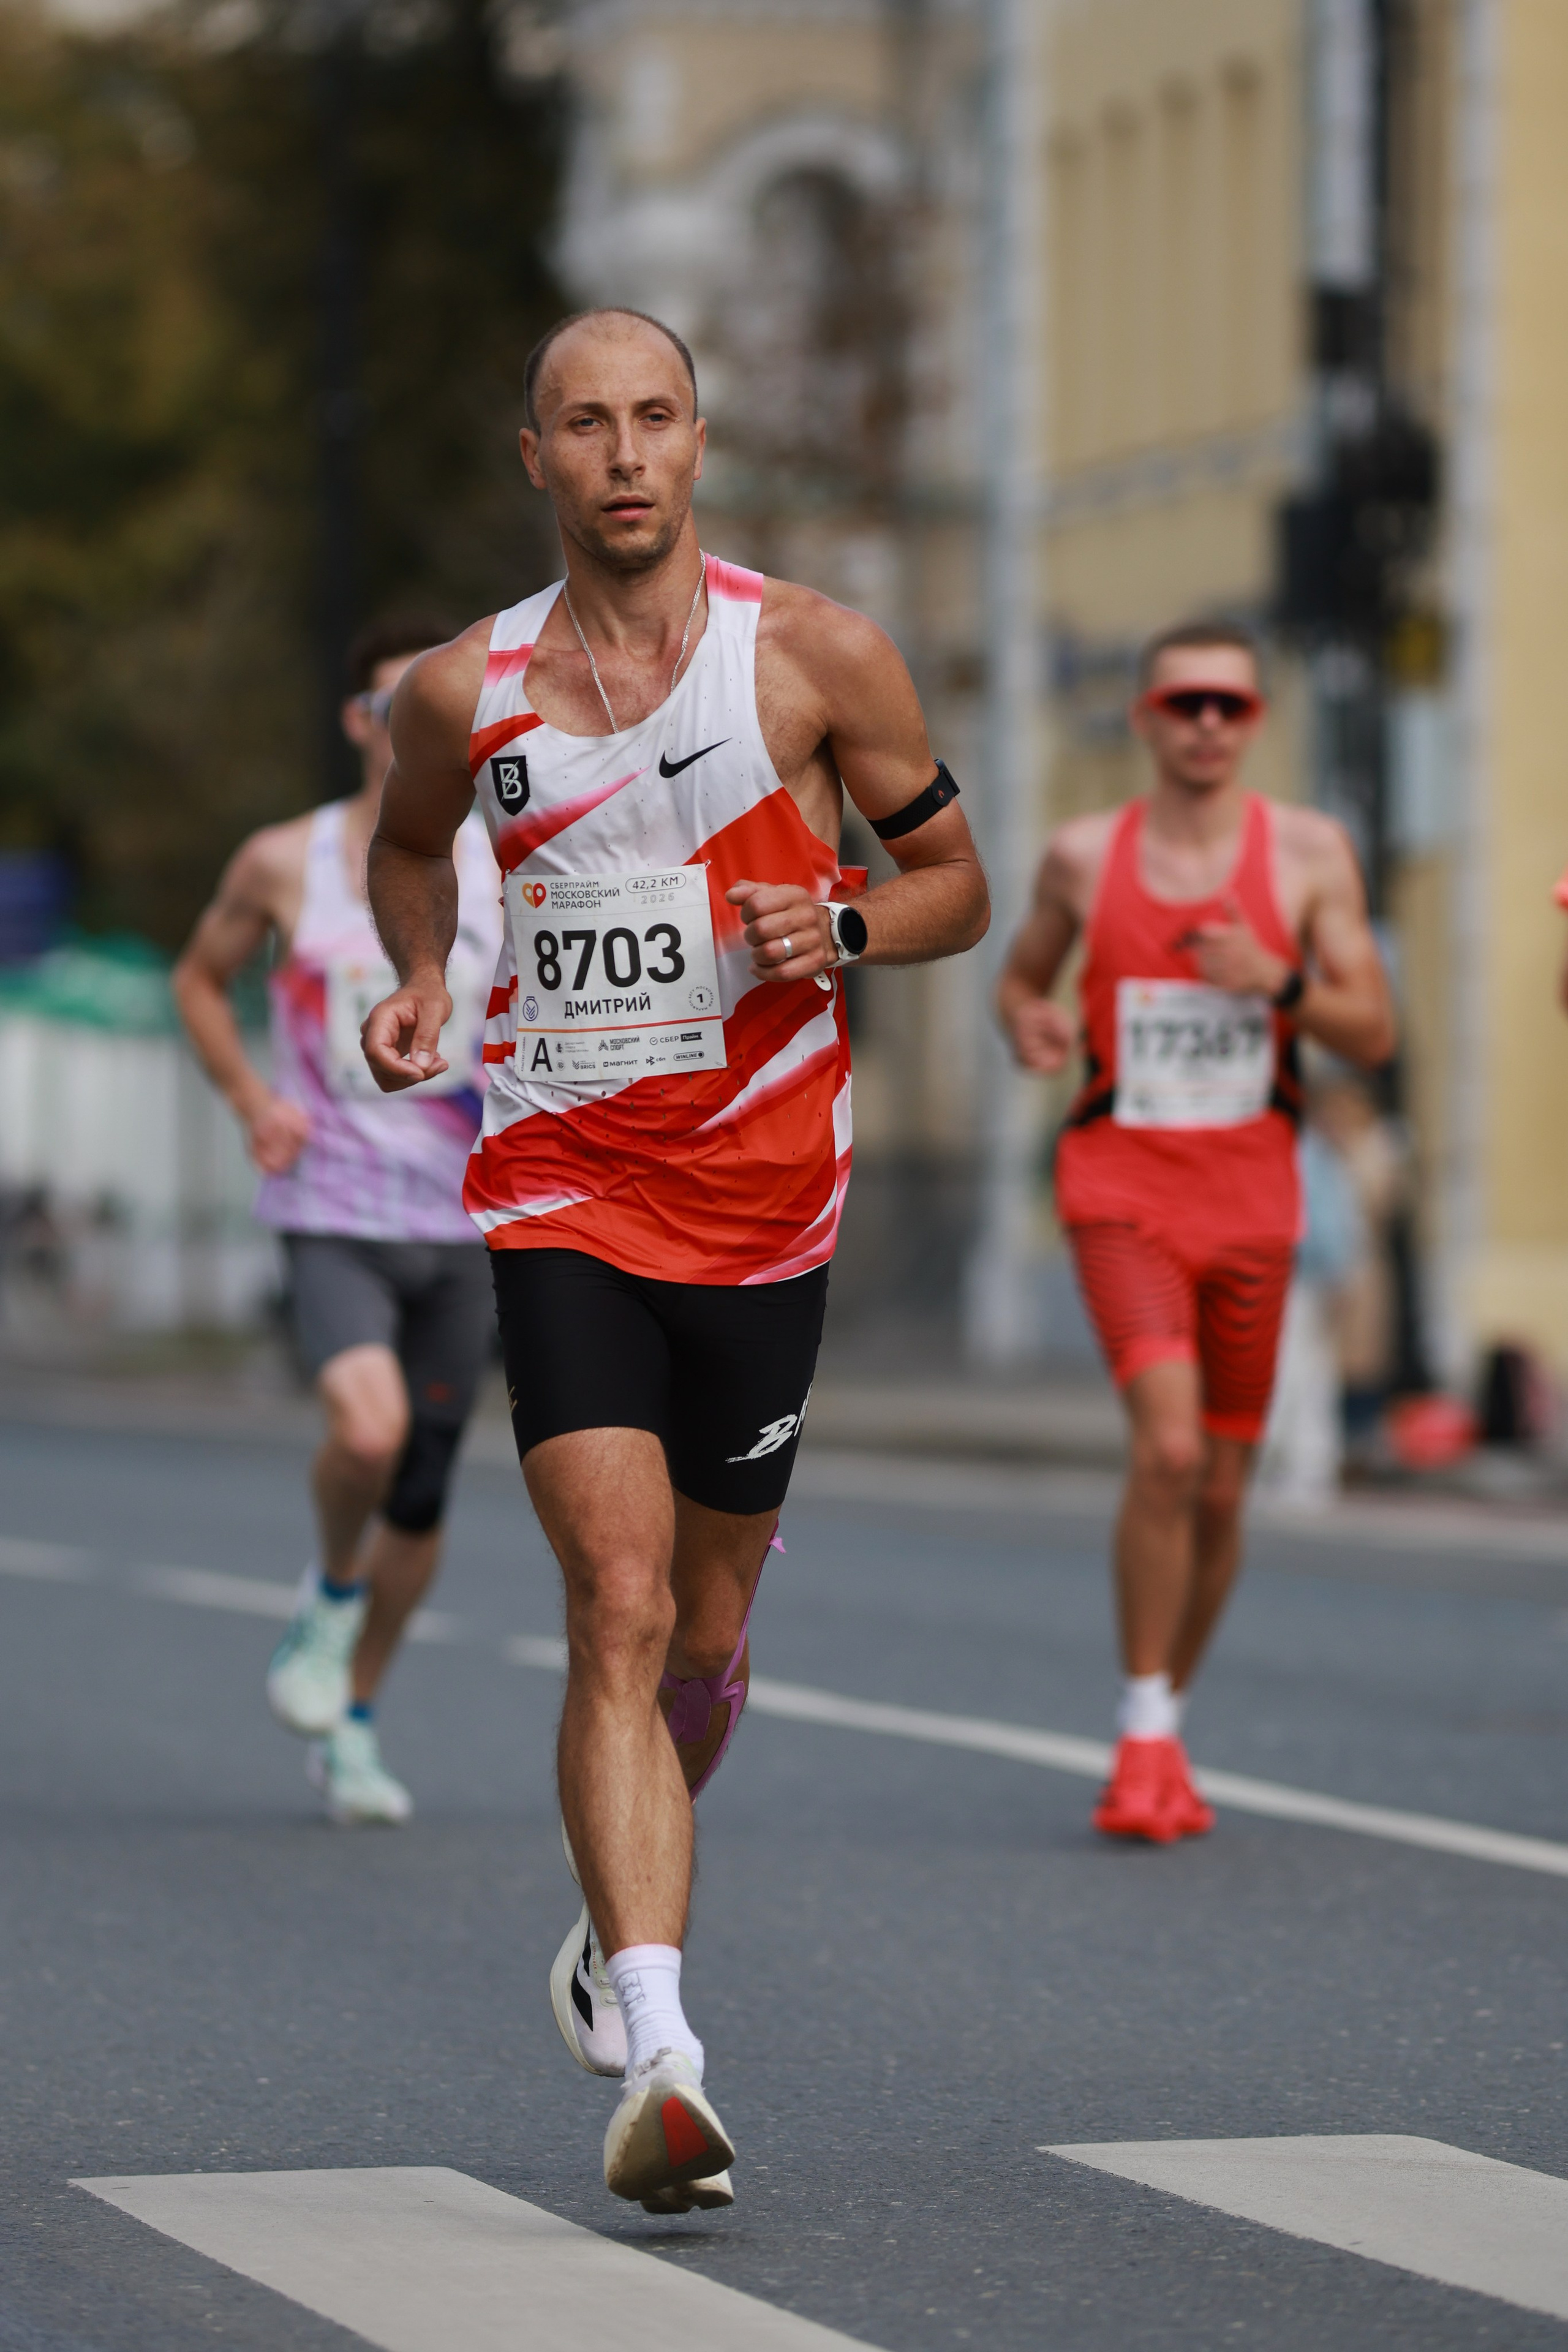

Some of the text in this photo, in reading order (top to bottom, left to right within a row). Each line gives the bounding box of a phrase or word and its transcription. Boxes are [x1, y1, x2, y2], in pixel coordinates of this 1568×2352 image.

[632, 878, 657, 890] 42,2
[551, 888, 620, 900] МОСКОВСКИЙ
[641, 892, 674, 905] 2026
[552, 900, 601, 909] МАРАФОН
[534, 923, 685, 990] 8703
[696, 993, 703, 1003] 1
[564, 992, 651, 1019] ДМИТРИЙ
[609, 1035, 640, 1045] МОСКОВСКИЙ
